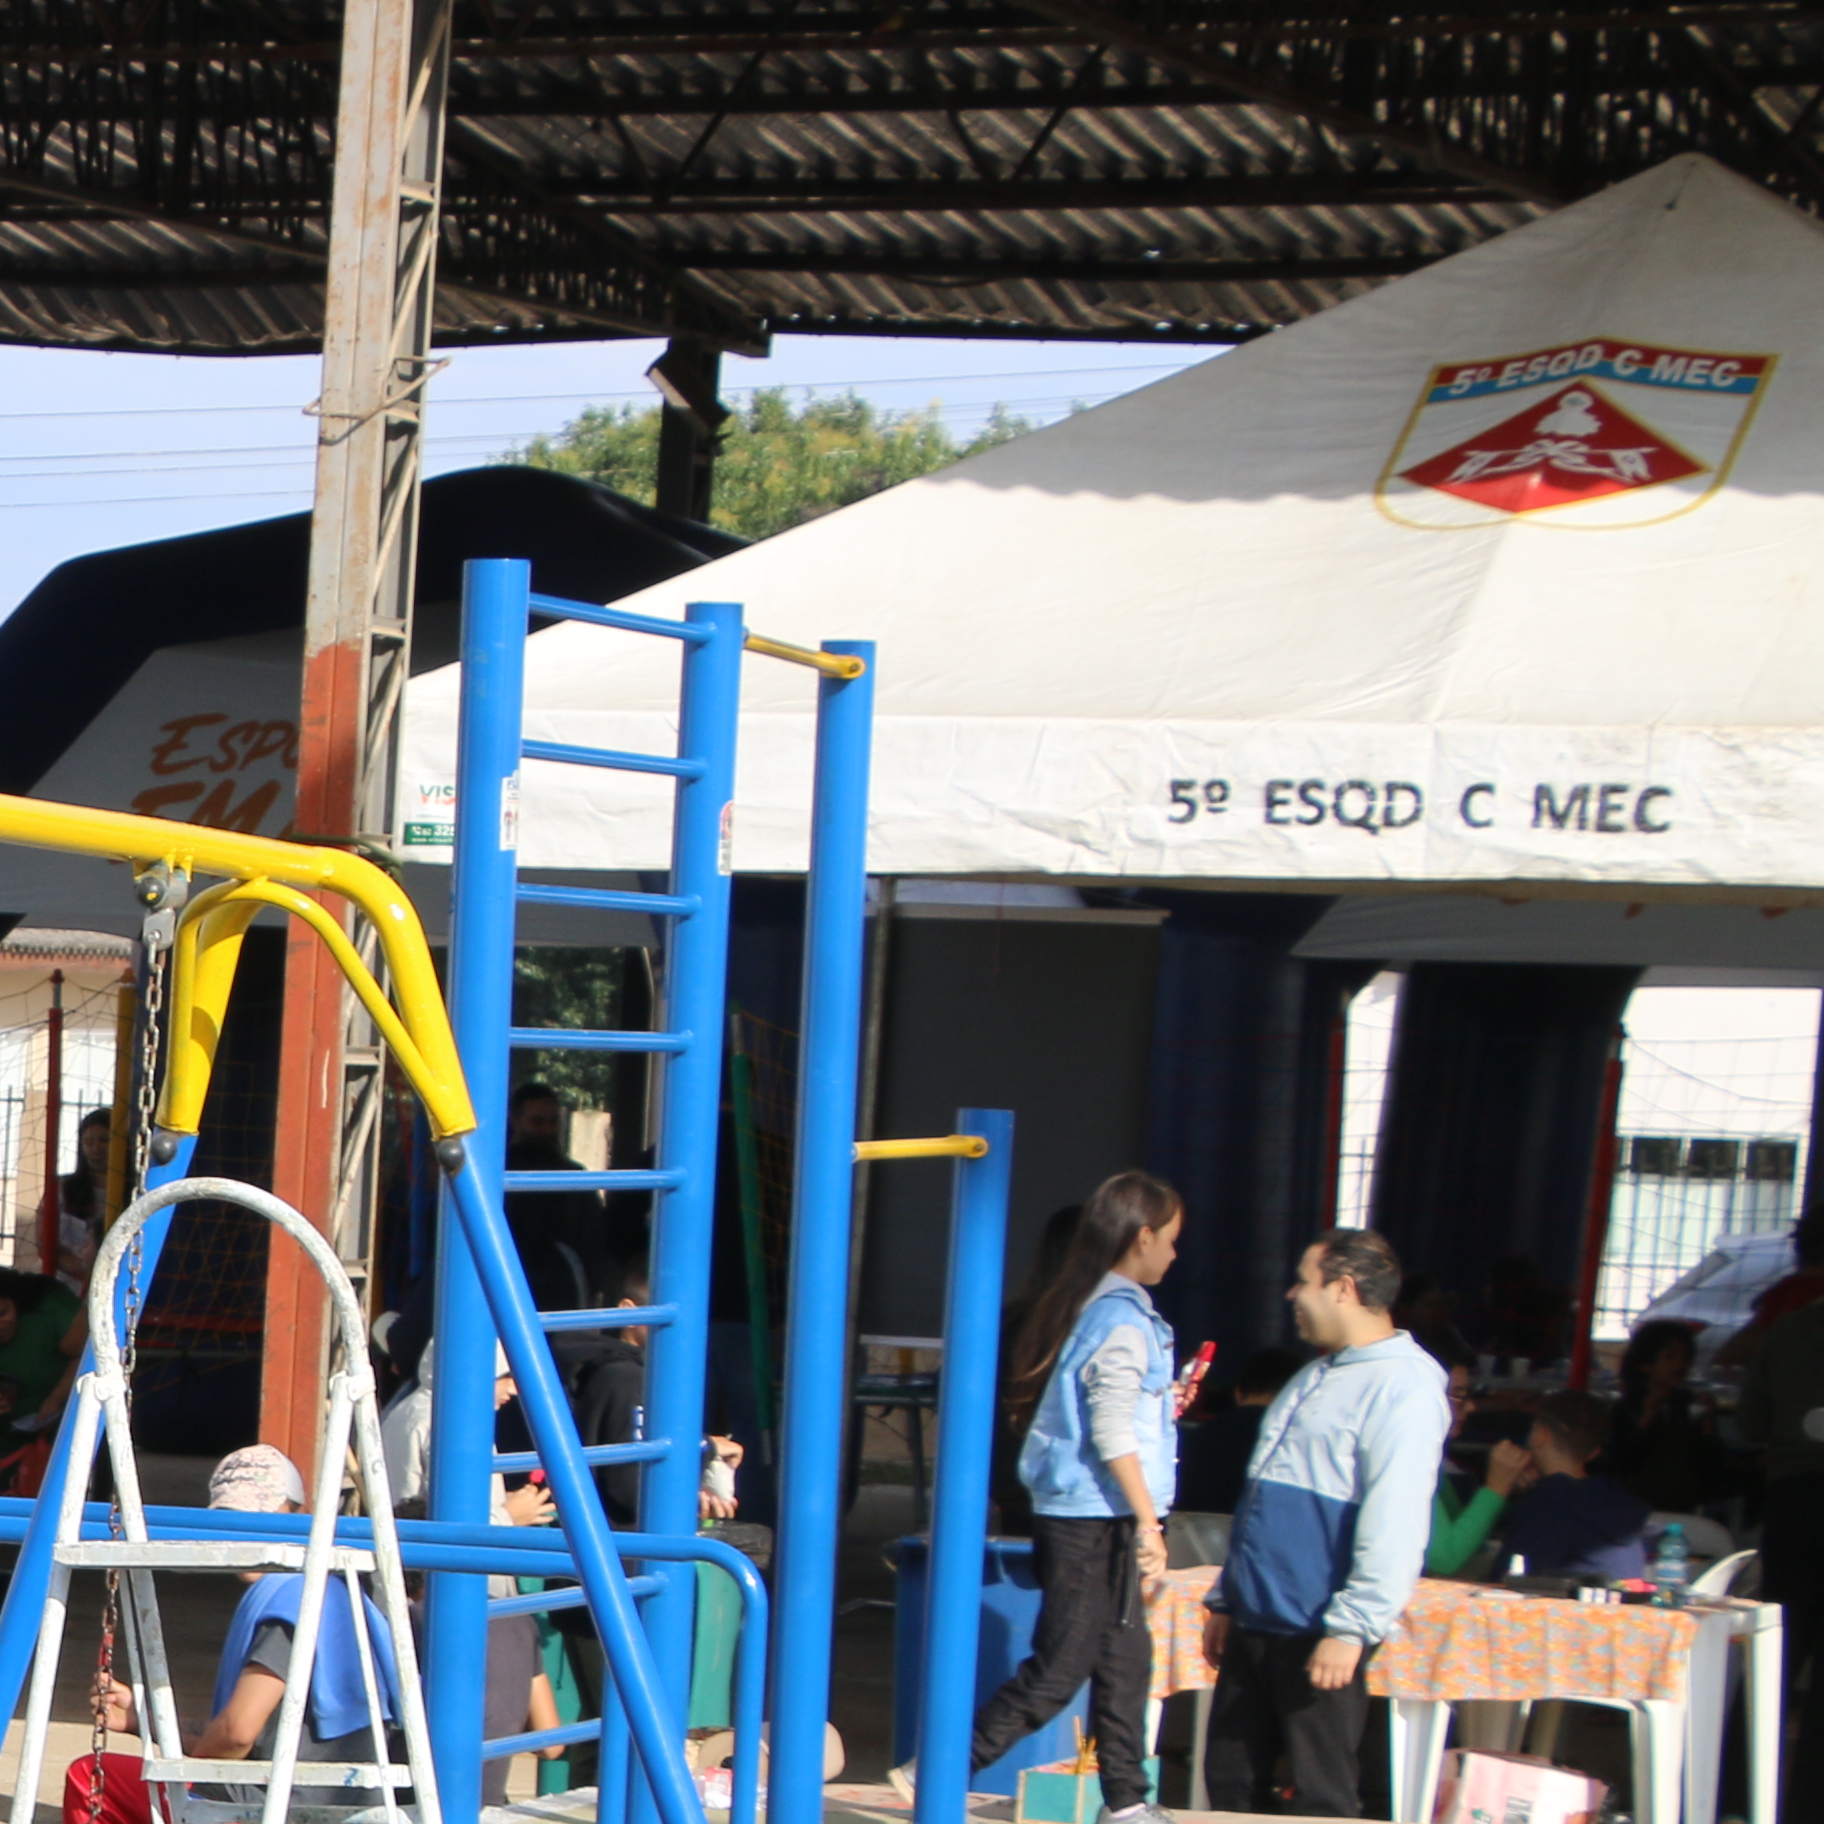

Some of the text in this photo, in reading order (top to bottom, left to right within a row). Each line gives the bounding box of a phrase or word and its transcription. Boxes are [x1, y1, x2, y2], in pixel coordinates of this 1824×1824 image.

[1497, 344, 1602, 388] ESQD
[1613, 349, 1644, 376] C
[1649, 354, 1742, 388] MEC
[1167, 779, 1673, 834] 5º ESQD C MEC
